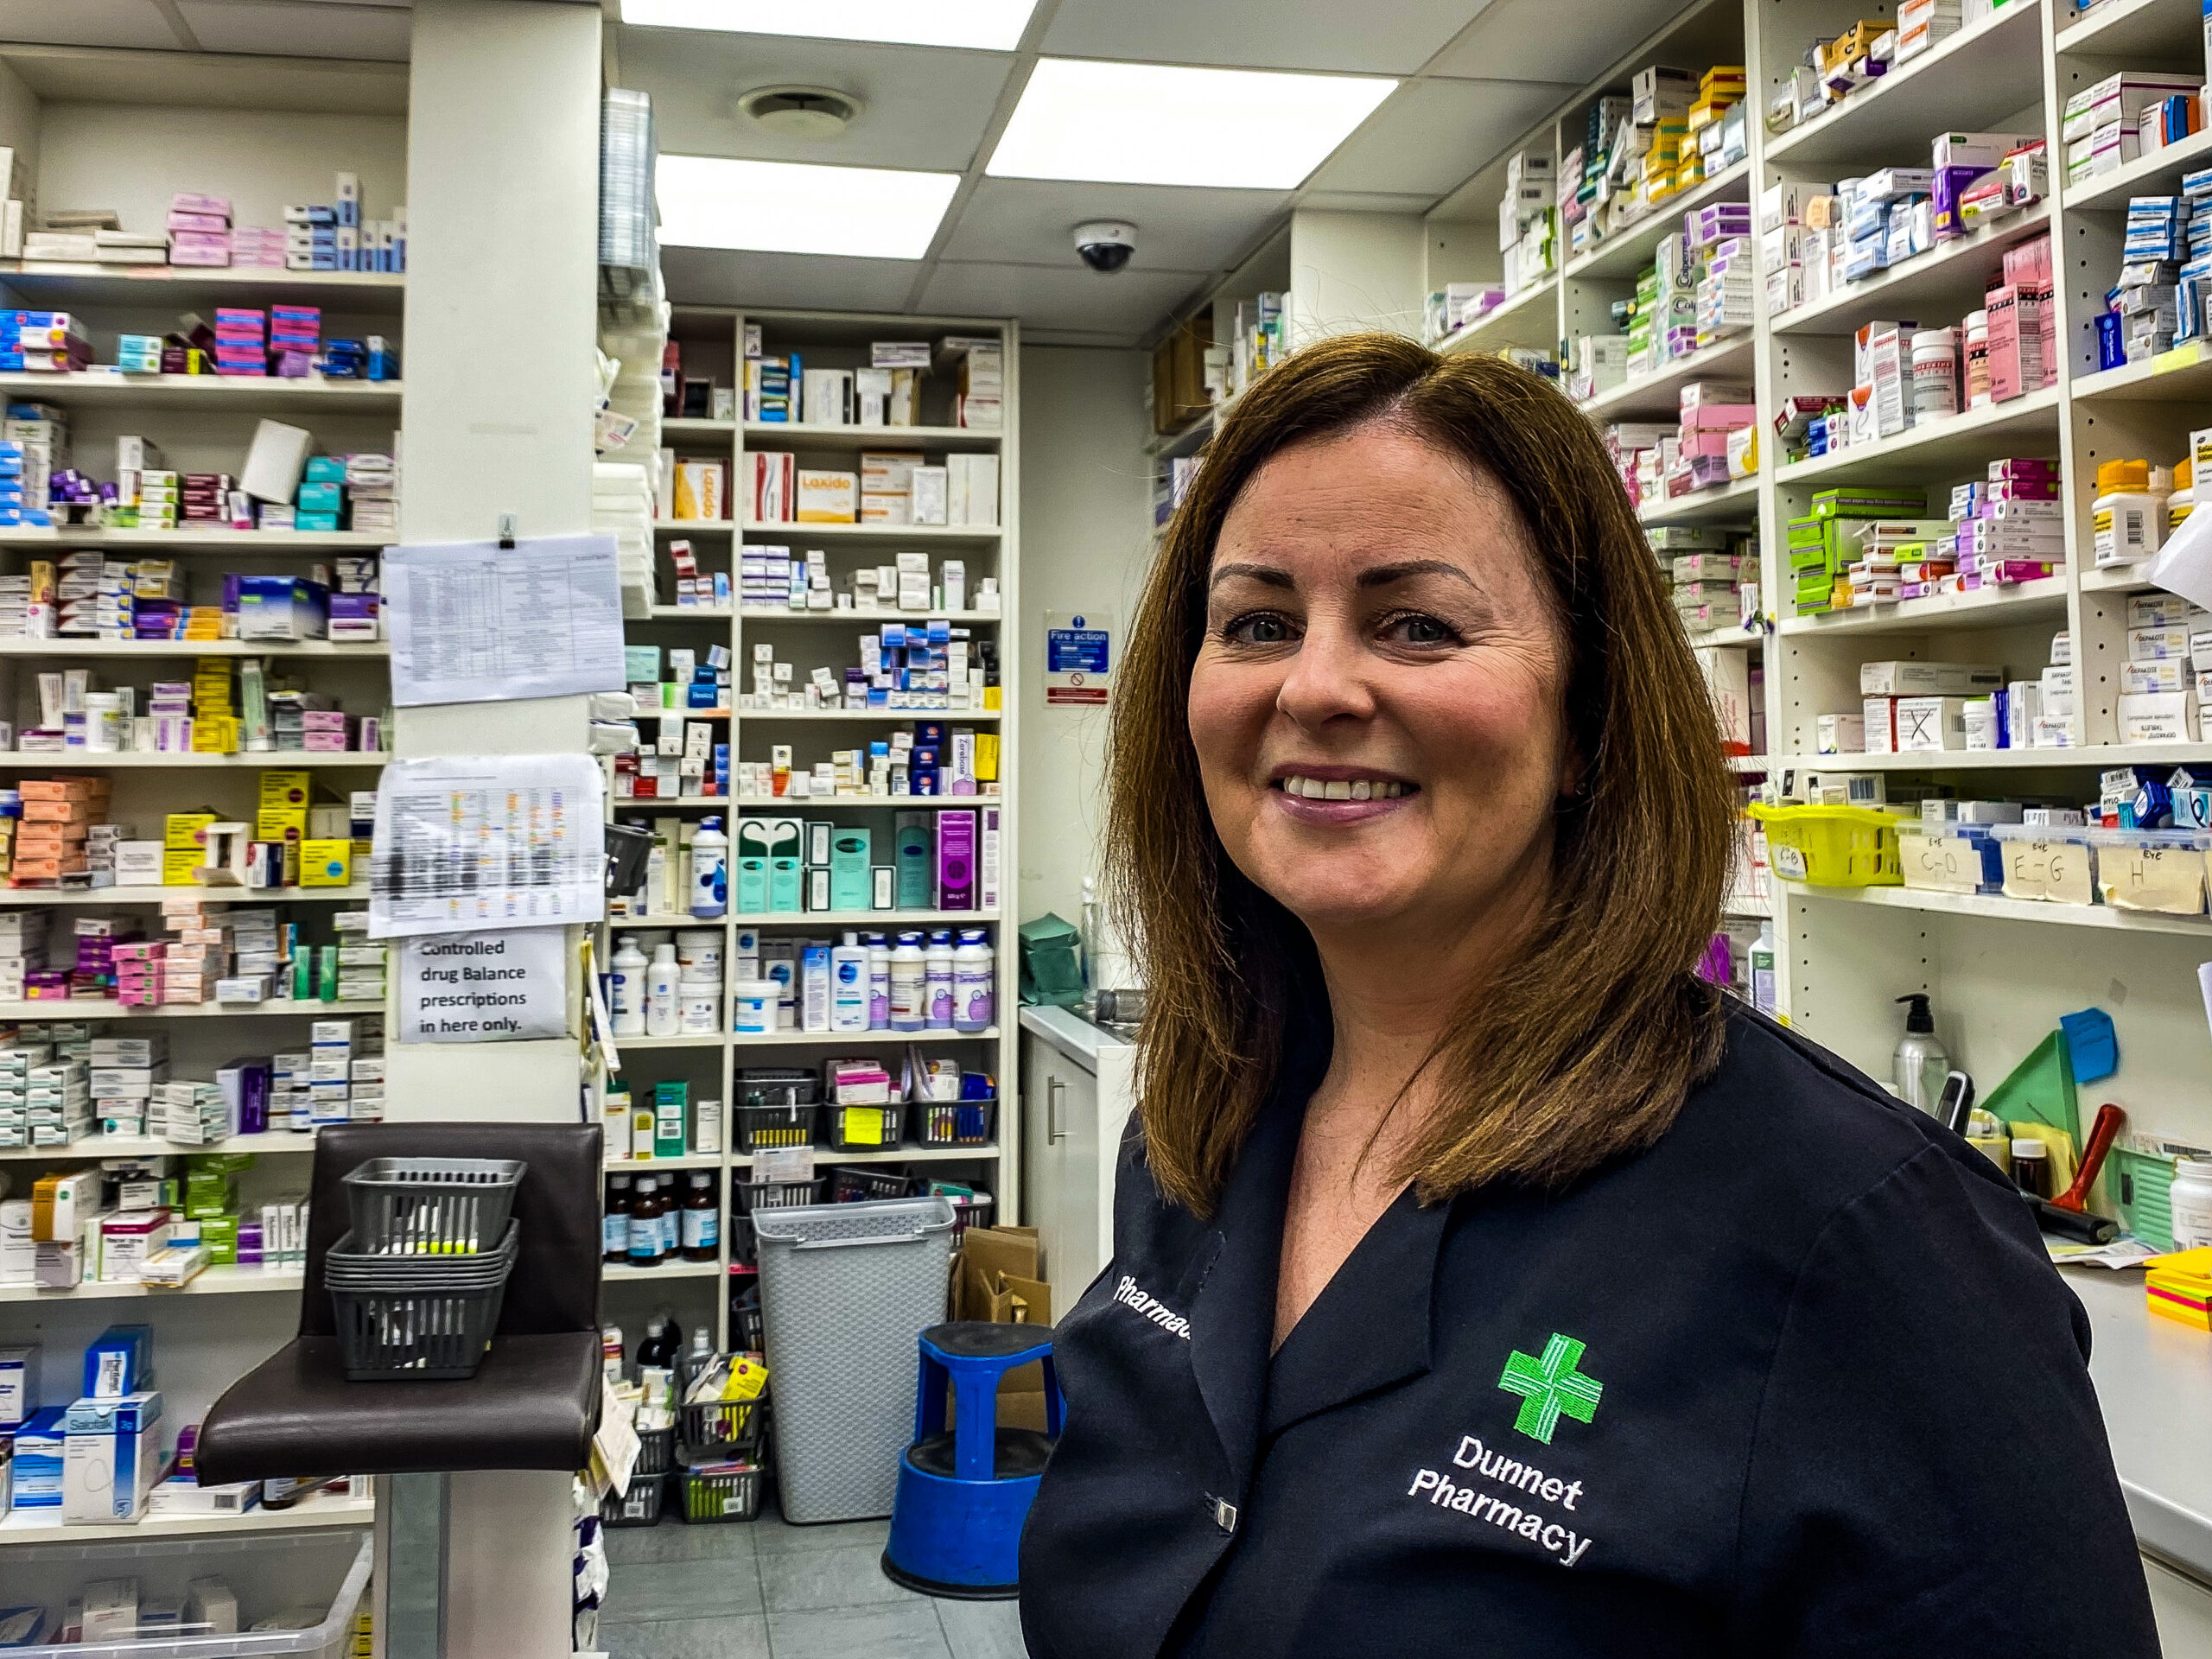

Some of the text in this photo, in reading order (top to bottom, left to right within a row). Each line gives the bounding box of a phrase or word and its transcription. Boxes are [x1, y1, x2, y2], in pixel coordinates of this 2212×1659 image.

[802, 477, 851, 490] Laxido
[703, 467, 717, 518] Laxido
[1051, 631, 1107, 641] Fire action
[2132, 860, 2145, 886] H
[420, 940, 505, 956] Controlled
[421, 966, 526, 983] drug Balance
[420, 992, 527, 1009] prescriptions
[420, 1016, 522, 1033] in here only.
[1113, 1275, 1191, 1340] Pharmac
[1452, 1435, 1584, 1511] Dunnet
[1408, 1468, 1593, 1567] Pharmacy
